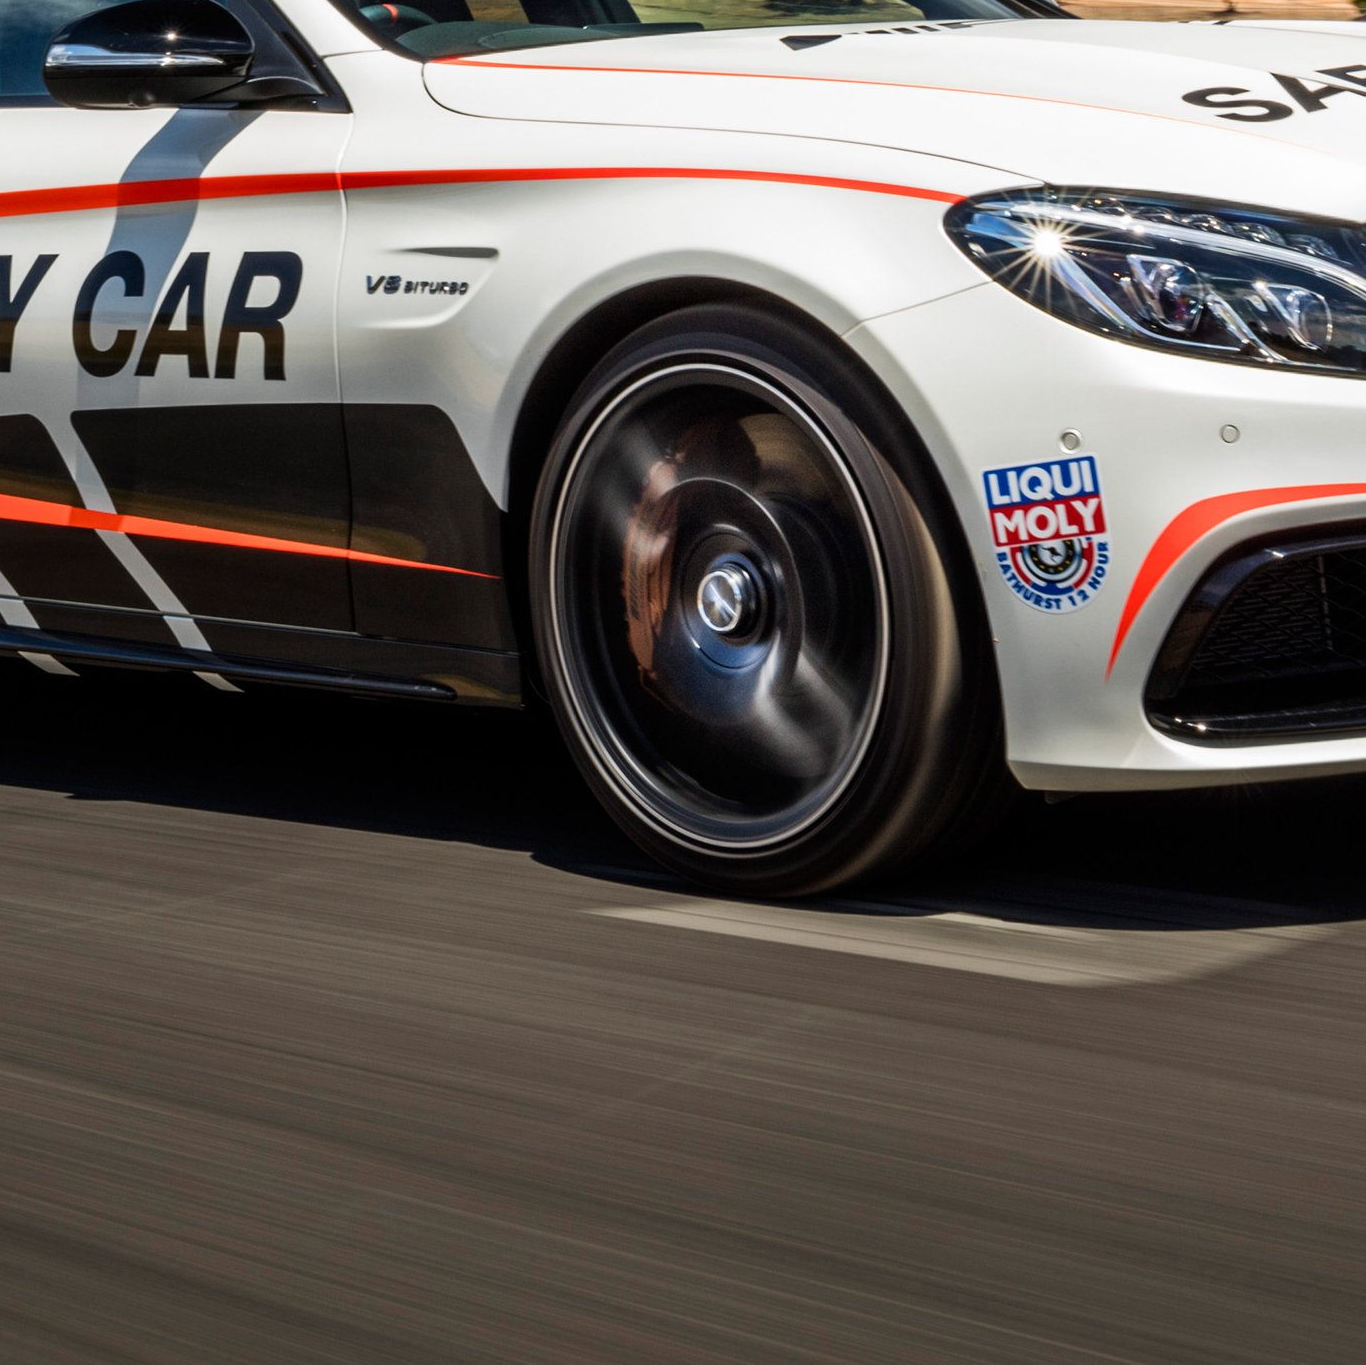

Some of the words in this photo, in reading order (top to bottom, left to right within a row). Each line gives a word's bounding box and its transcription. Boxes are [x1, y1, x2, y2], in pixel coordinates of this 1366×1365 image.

[366, 275, 401, 294] V8
[404, 281, 469, 295] BITURBO
[72, 250, 303, 381] CAR
[988, 460, 1095, 505] LIQUI
[993, 498, 1100, 543] MOLY
[996, 552, 1062, 610] BATHURST
[1067, 589, 1090, 606] 12
[1088, 541, 1109, 590] HOUR
